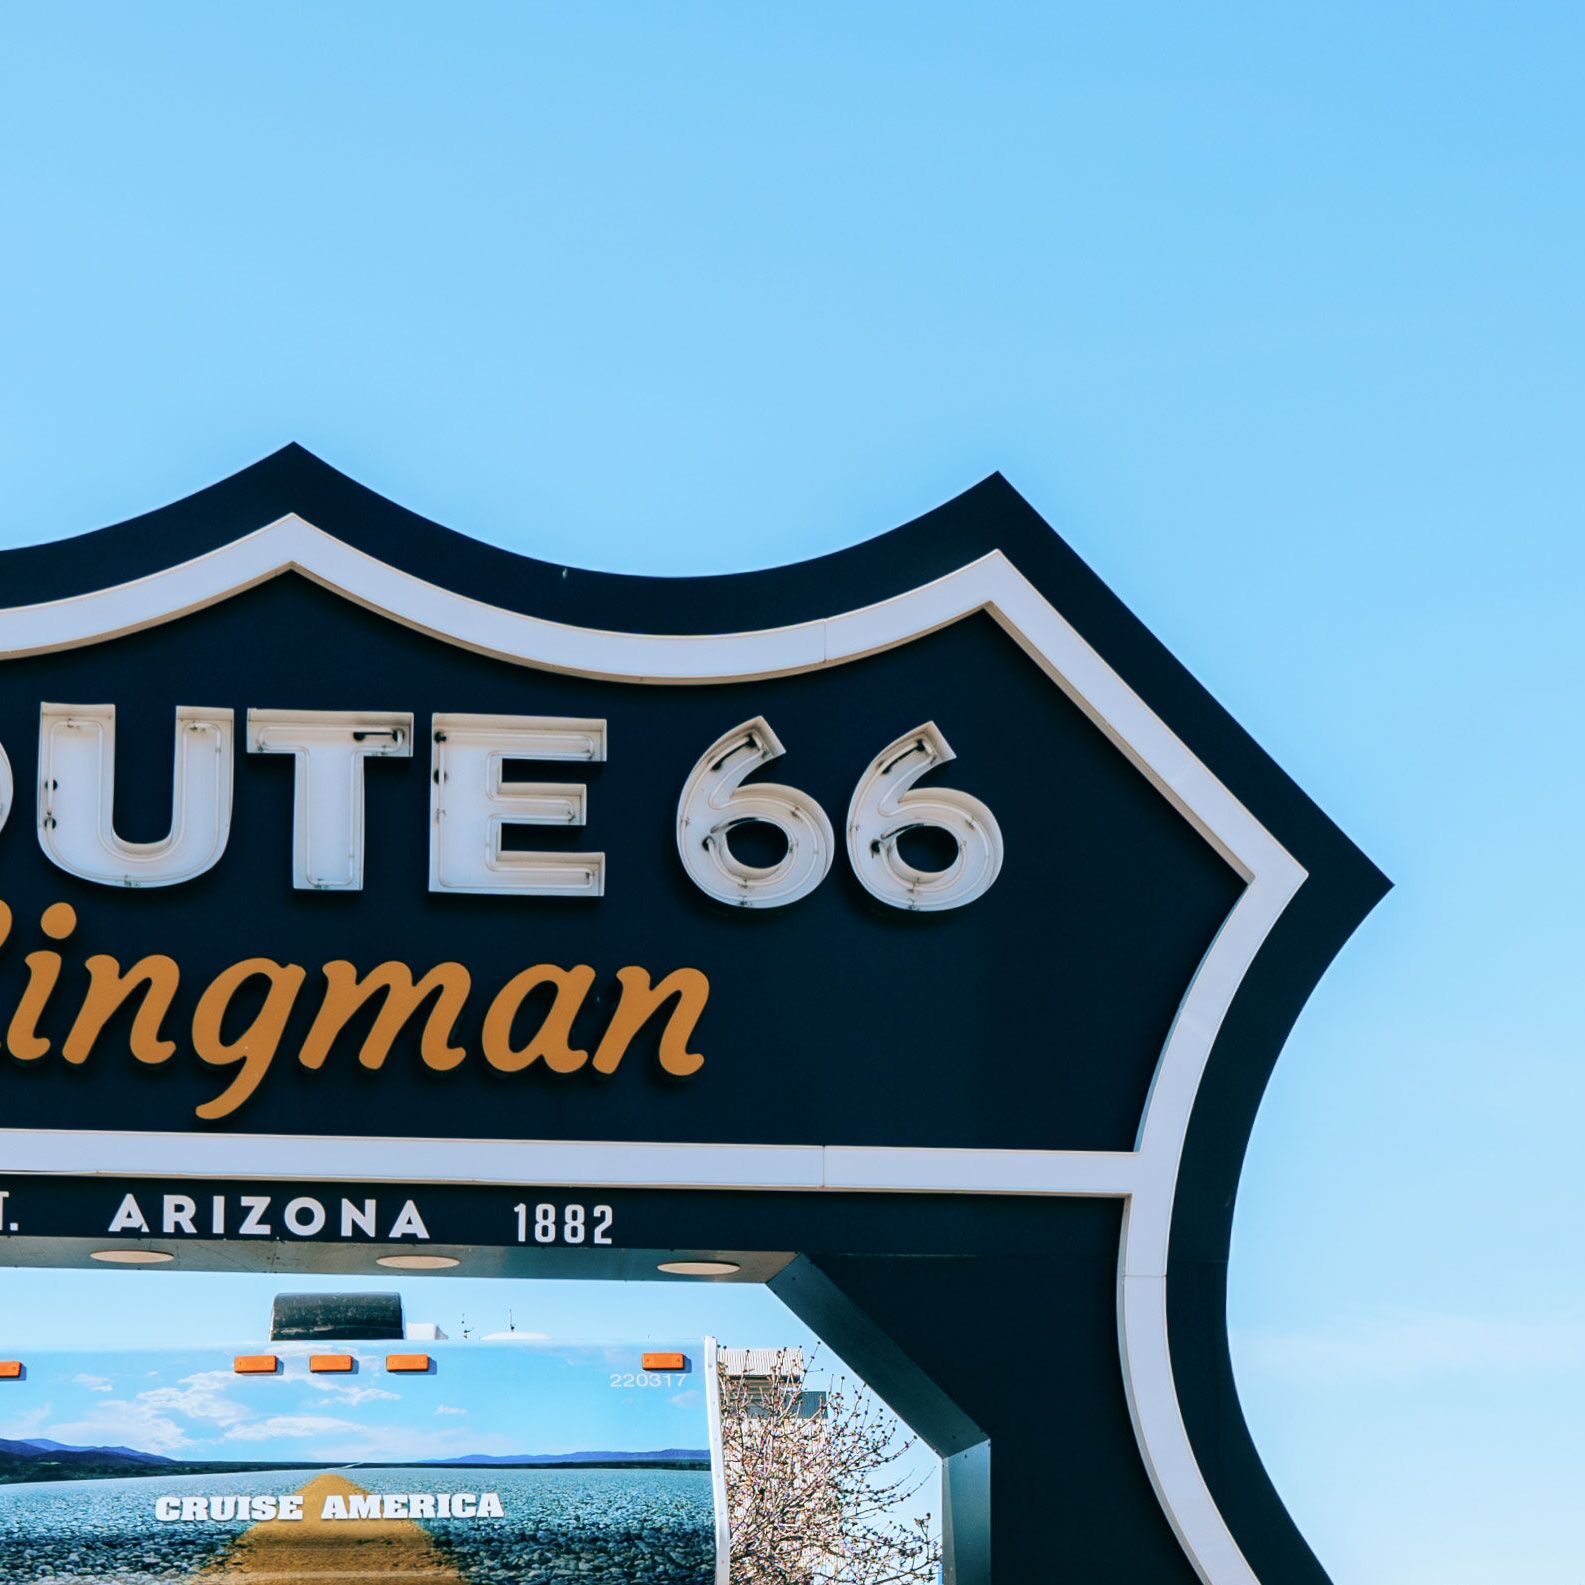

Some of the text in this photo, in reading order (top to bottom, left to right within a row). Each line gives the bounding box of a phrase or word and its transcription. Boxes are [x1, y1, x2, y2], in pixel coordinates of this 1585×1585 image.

[675, 715, 1004, 912] 66
[108, 1193, 430, 1240] ARIZONA
[513, 1202, 614, 1246] 1882
[609, 1373, 688, 1388] 220317
[154, 1491, 505, 1522] CRUISE AMERICA
